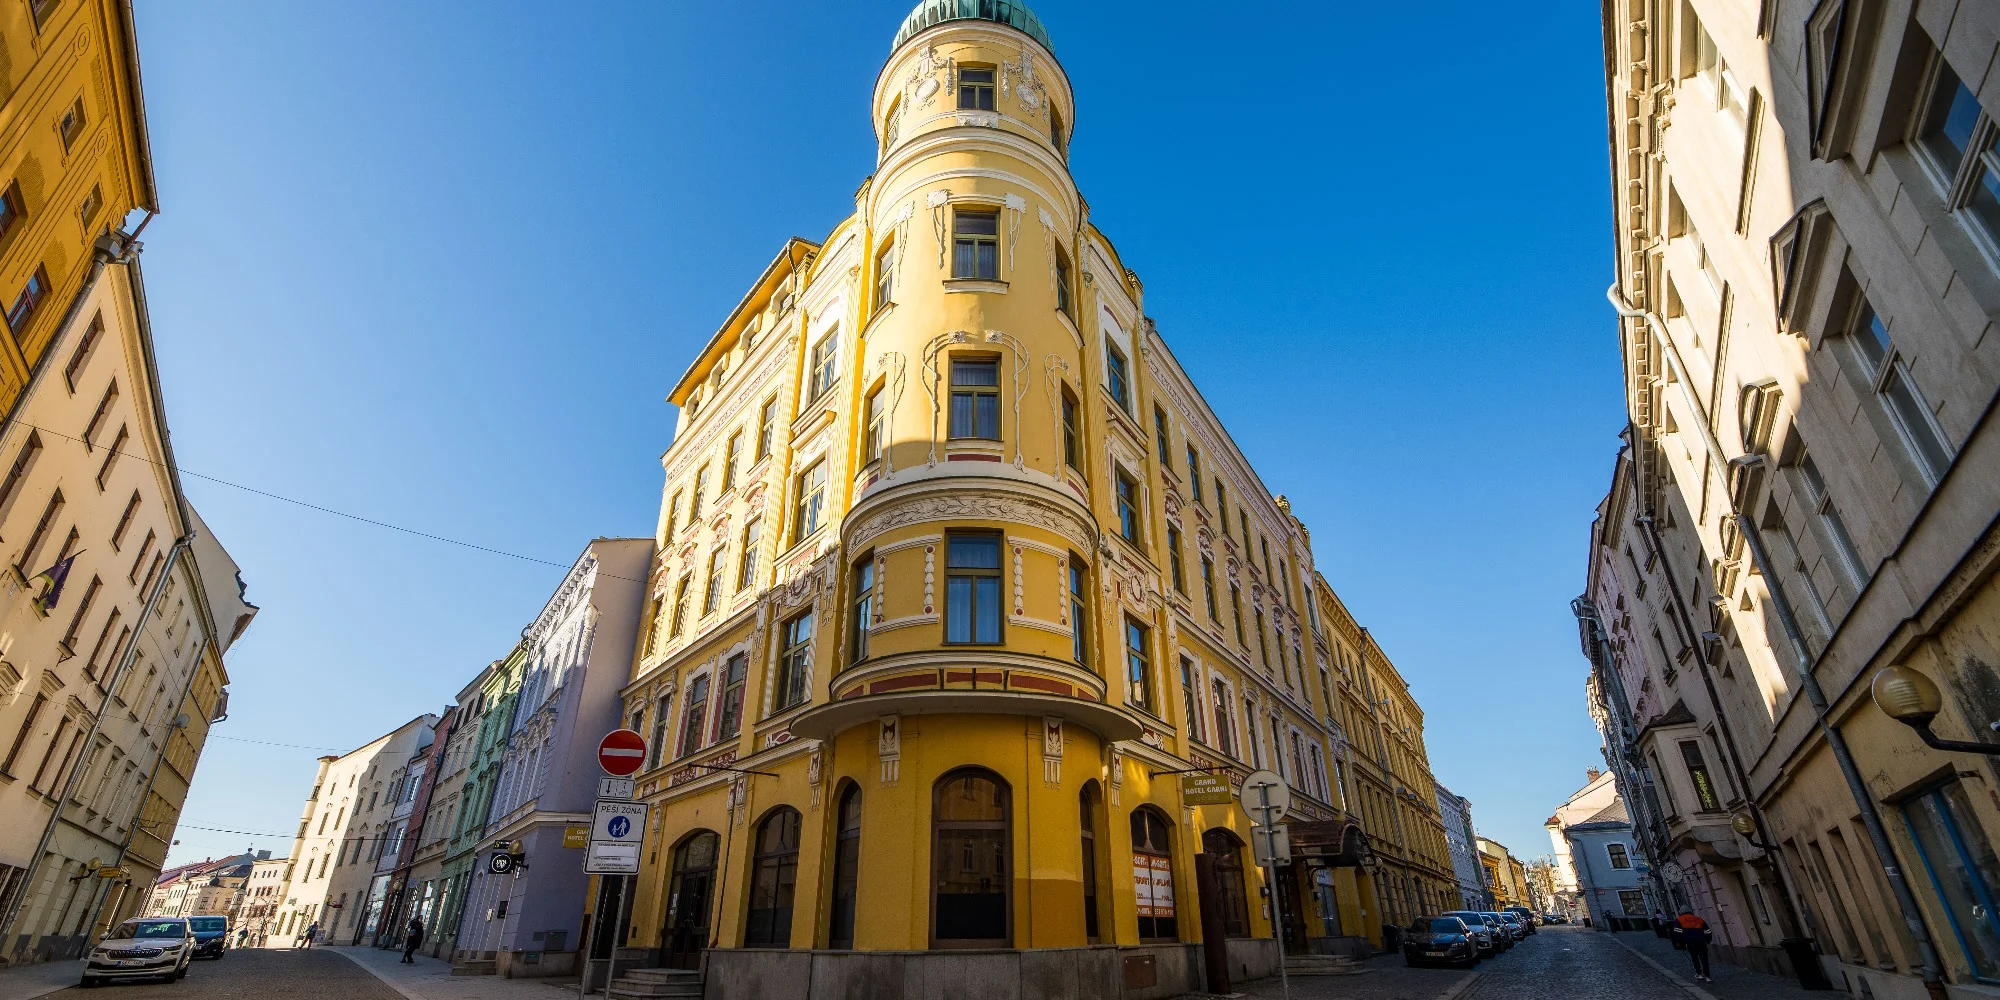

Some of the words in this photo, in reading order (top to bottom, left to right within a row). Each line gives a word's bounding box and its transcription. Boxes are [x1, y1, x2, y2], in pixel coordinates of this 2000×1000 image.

[1194, 778, 1216, 786] GRAND
[1185, 787, 1206, 795] HOTEL
[1206, 785, 1228, 793] GARNI
[600, 804, 619, 814] PĚŠÍ
[621, 805, 642, 815] ZÓNA
